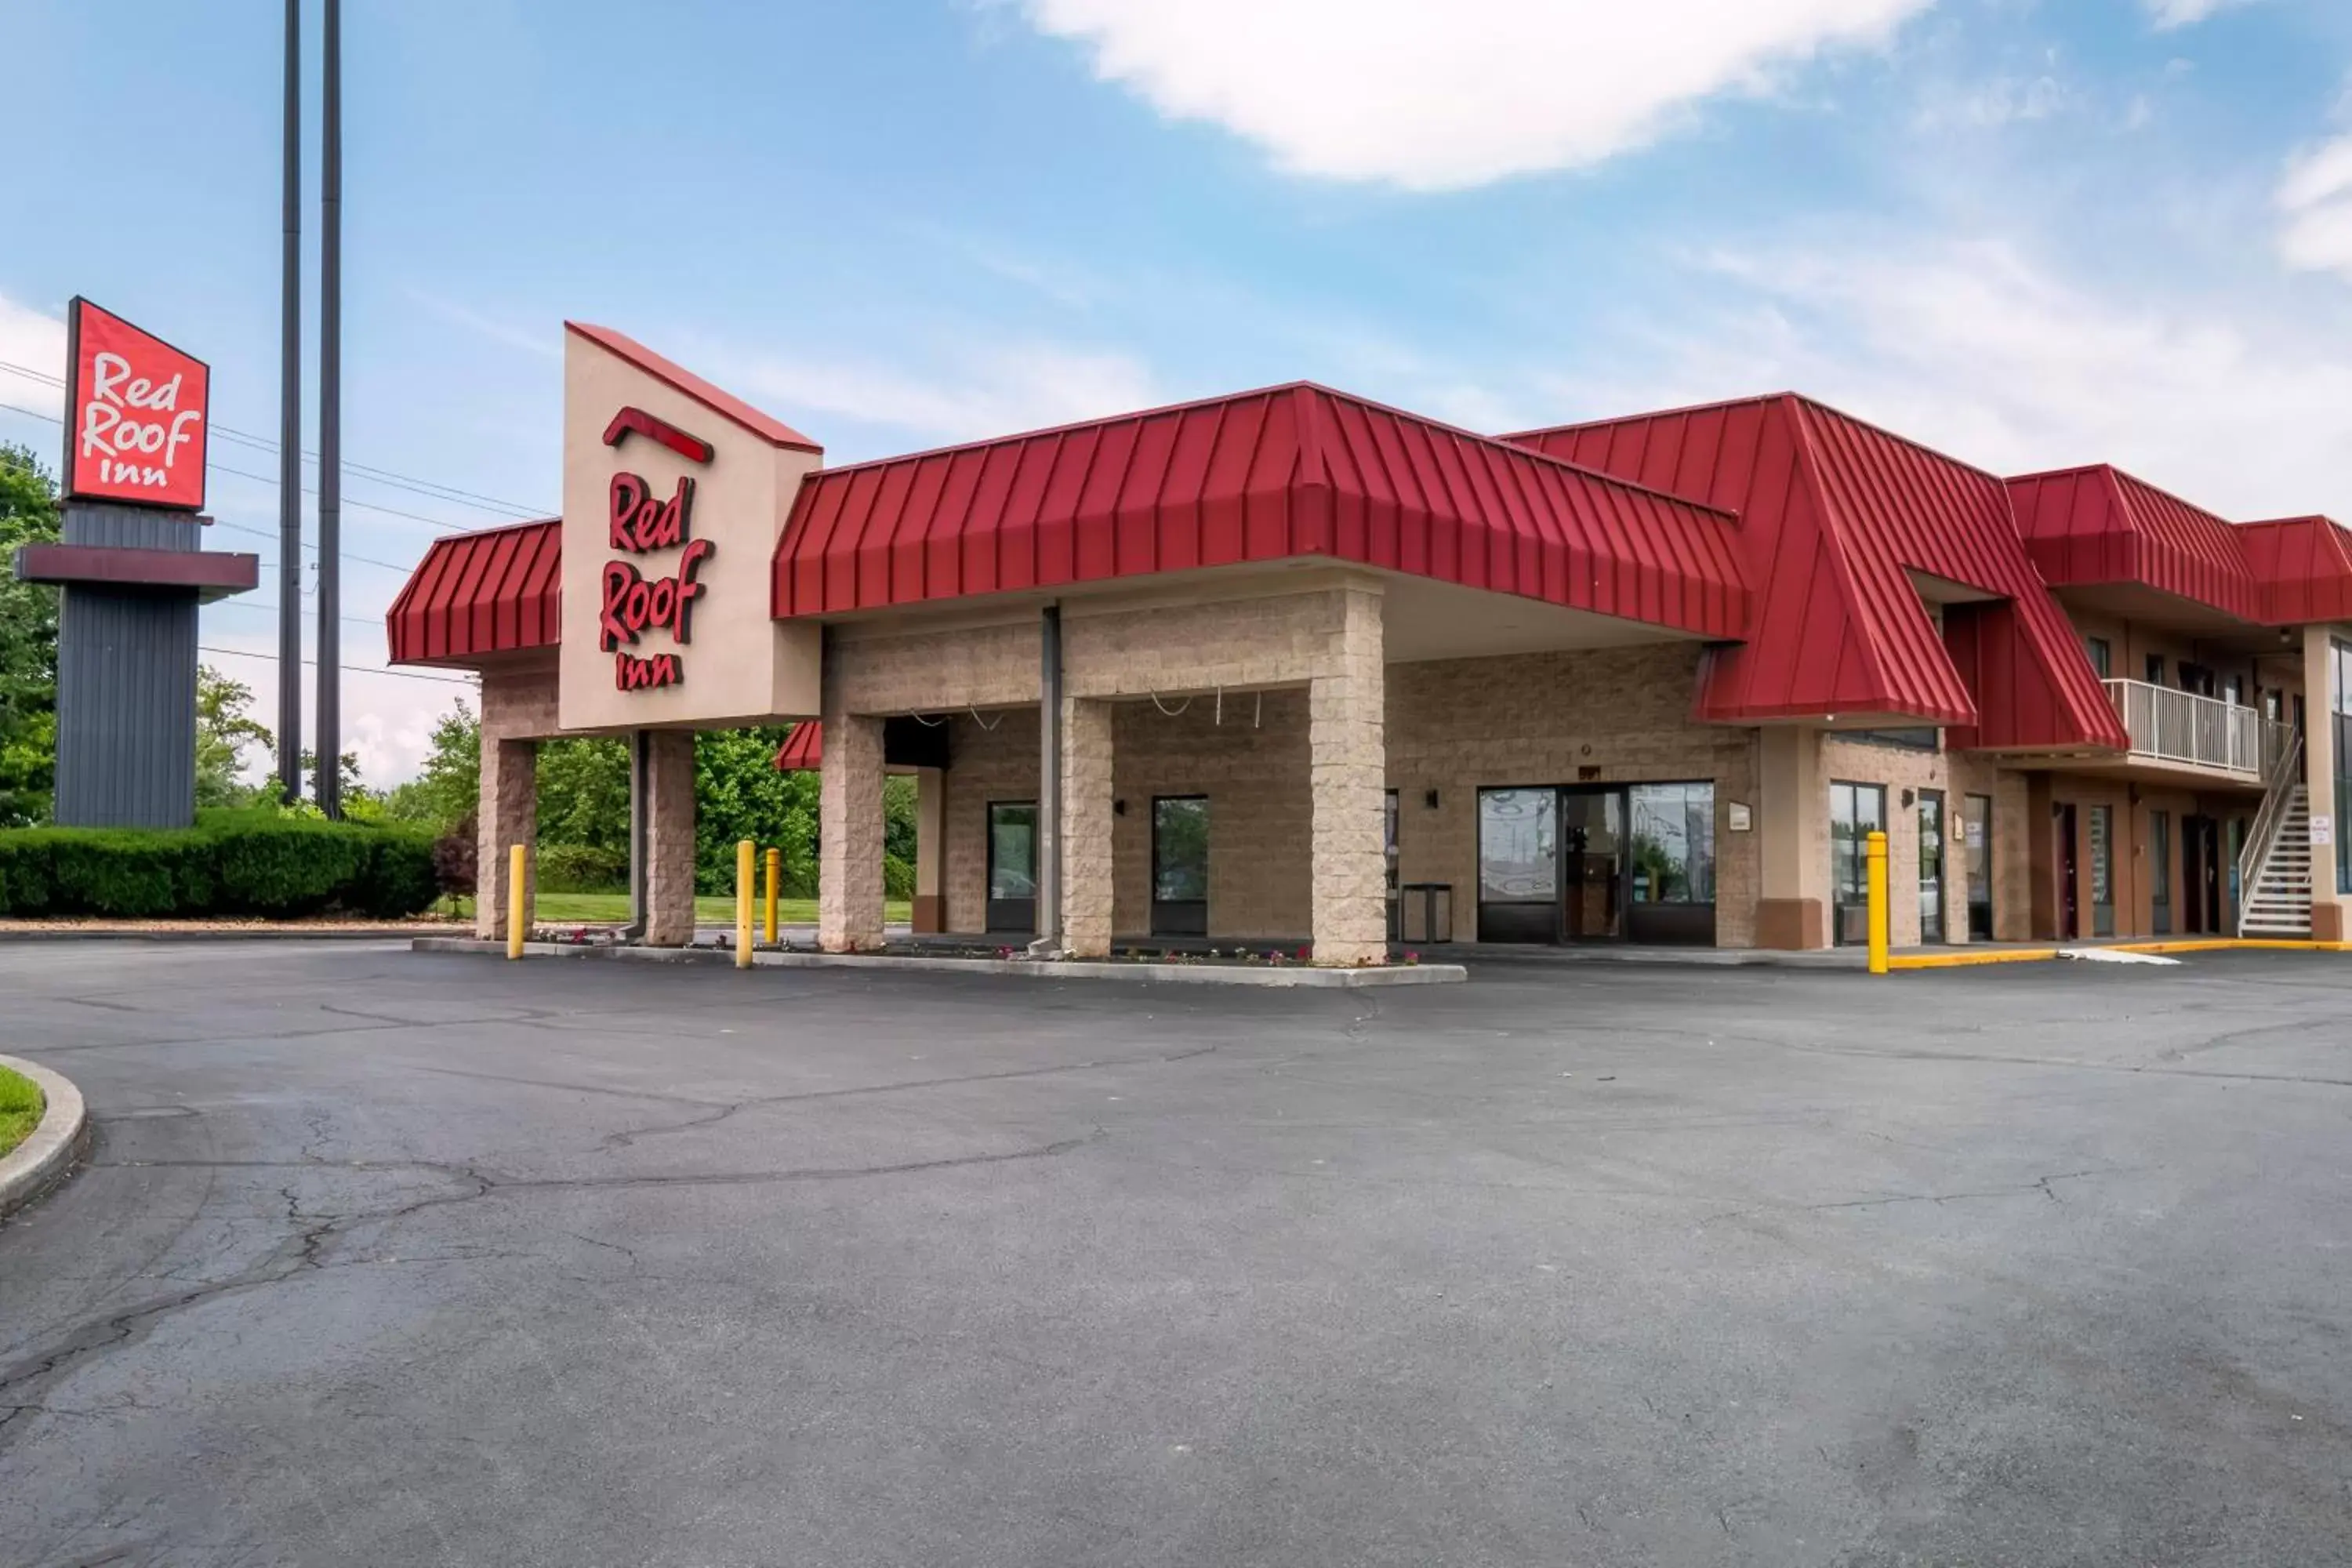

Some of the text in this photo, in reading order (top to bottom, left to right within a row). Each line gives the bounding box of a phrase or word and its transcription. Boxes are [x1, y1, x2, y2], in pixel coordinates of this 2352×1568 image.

[94, 352, 182, 412] Red
[82, 401, 201, 468] Roof
[610, 472, 695, 553] Red
[600, 539, 715, 652] Roof
